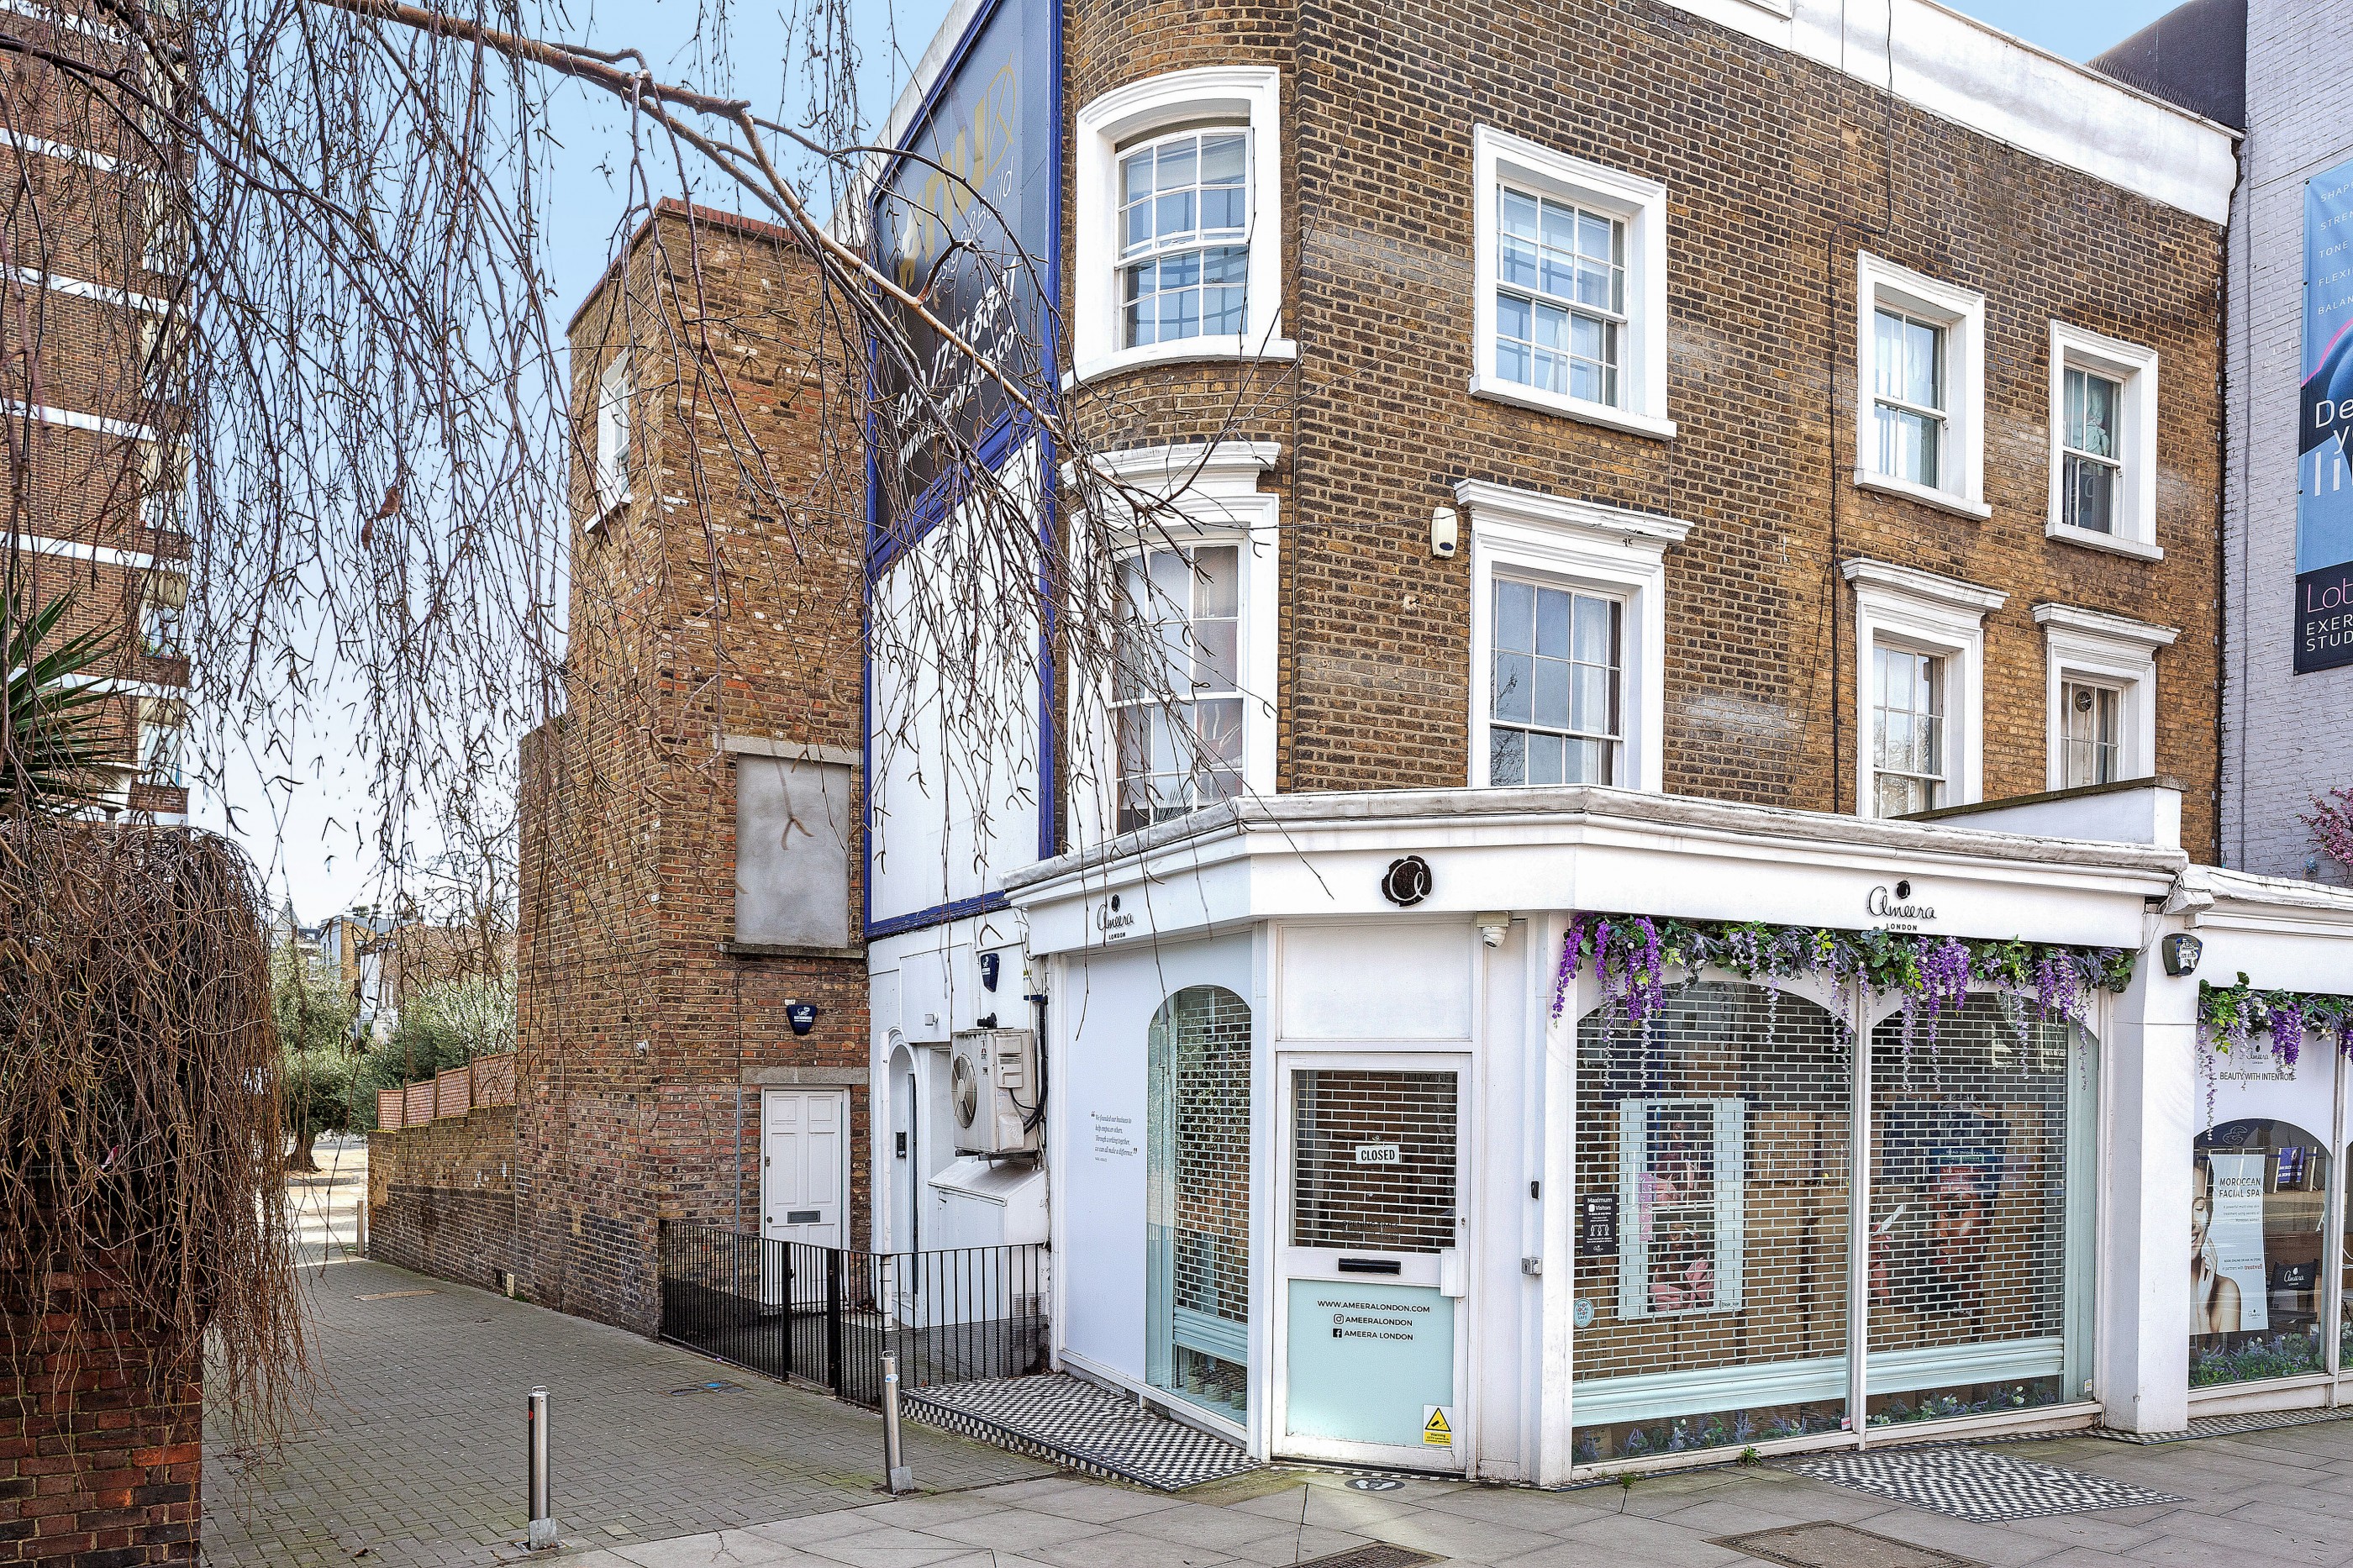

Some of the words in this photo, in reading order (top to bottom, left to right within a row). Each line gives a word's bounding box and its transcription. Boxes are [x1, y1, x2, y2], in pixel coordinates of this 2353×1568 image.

[2319, 240, 2349, 259] TONE
[2319, 266, 2353, 287] FLEXI
[2333, 425, 2353, 455] y
[2314, 450, 2353, 497] li
[1868, 886, 1938, 919] Ameera
[1097, 903, 1134, 931] Ameera
[1886, 923, 1919, 932] LONDON
[1108, 931, 1126, 940] LONDON
[2219, 1071, 2244, 1081] BEAUTY
[2245, 1072, 2261, 1081] WITH
[1361, 1150, 1396, 1161] CLOSED
[2219, 1177, 2261, 1187] MOROCCAN
[2219, 1189, 2244, 1198] FACIAL
[2246, 1188, 2261, 1197] SPA
[1317, 1300, 1430, 1313] WWW.AMEERALONDON.COM
[1345, 1316, 1413, 1327] AMEERALONDON
[1344, 1329, 1378, 1339] AMEERA
[1379, 1331, 1413, 1341] LONDON
